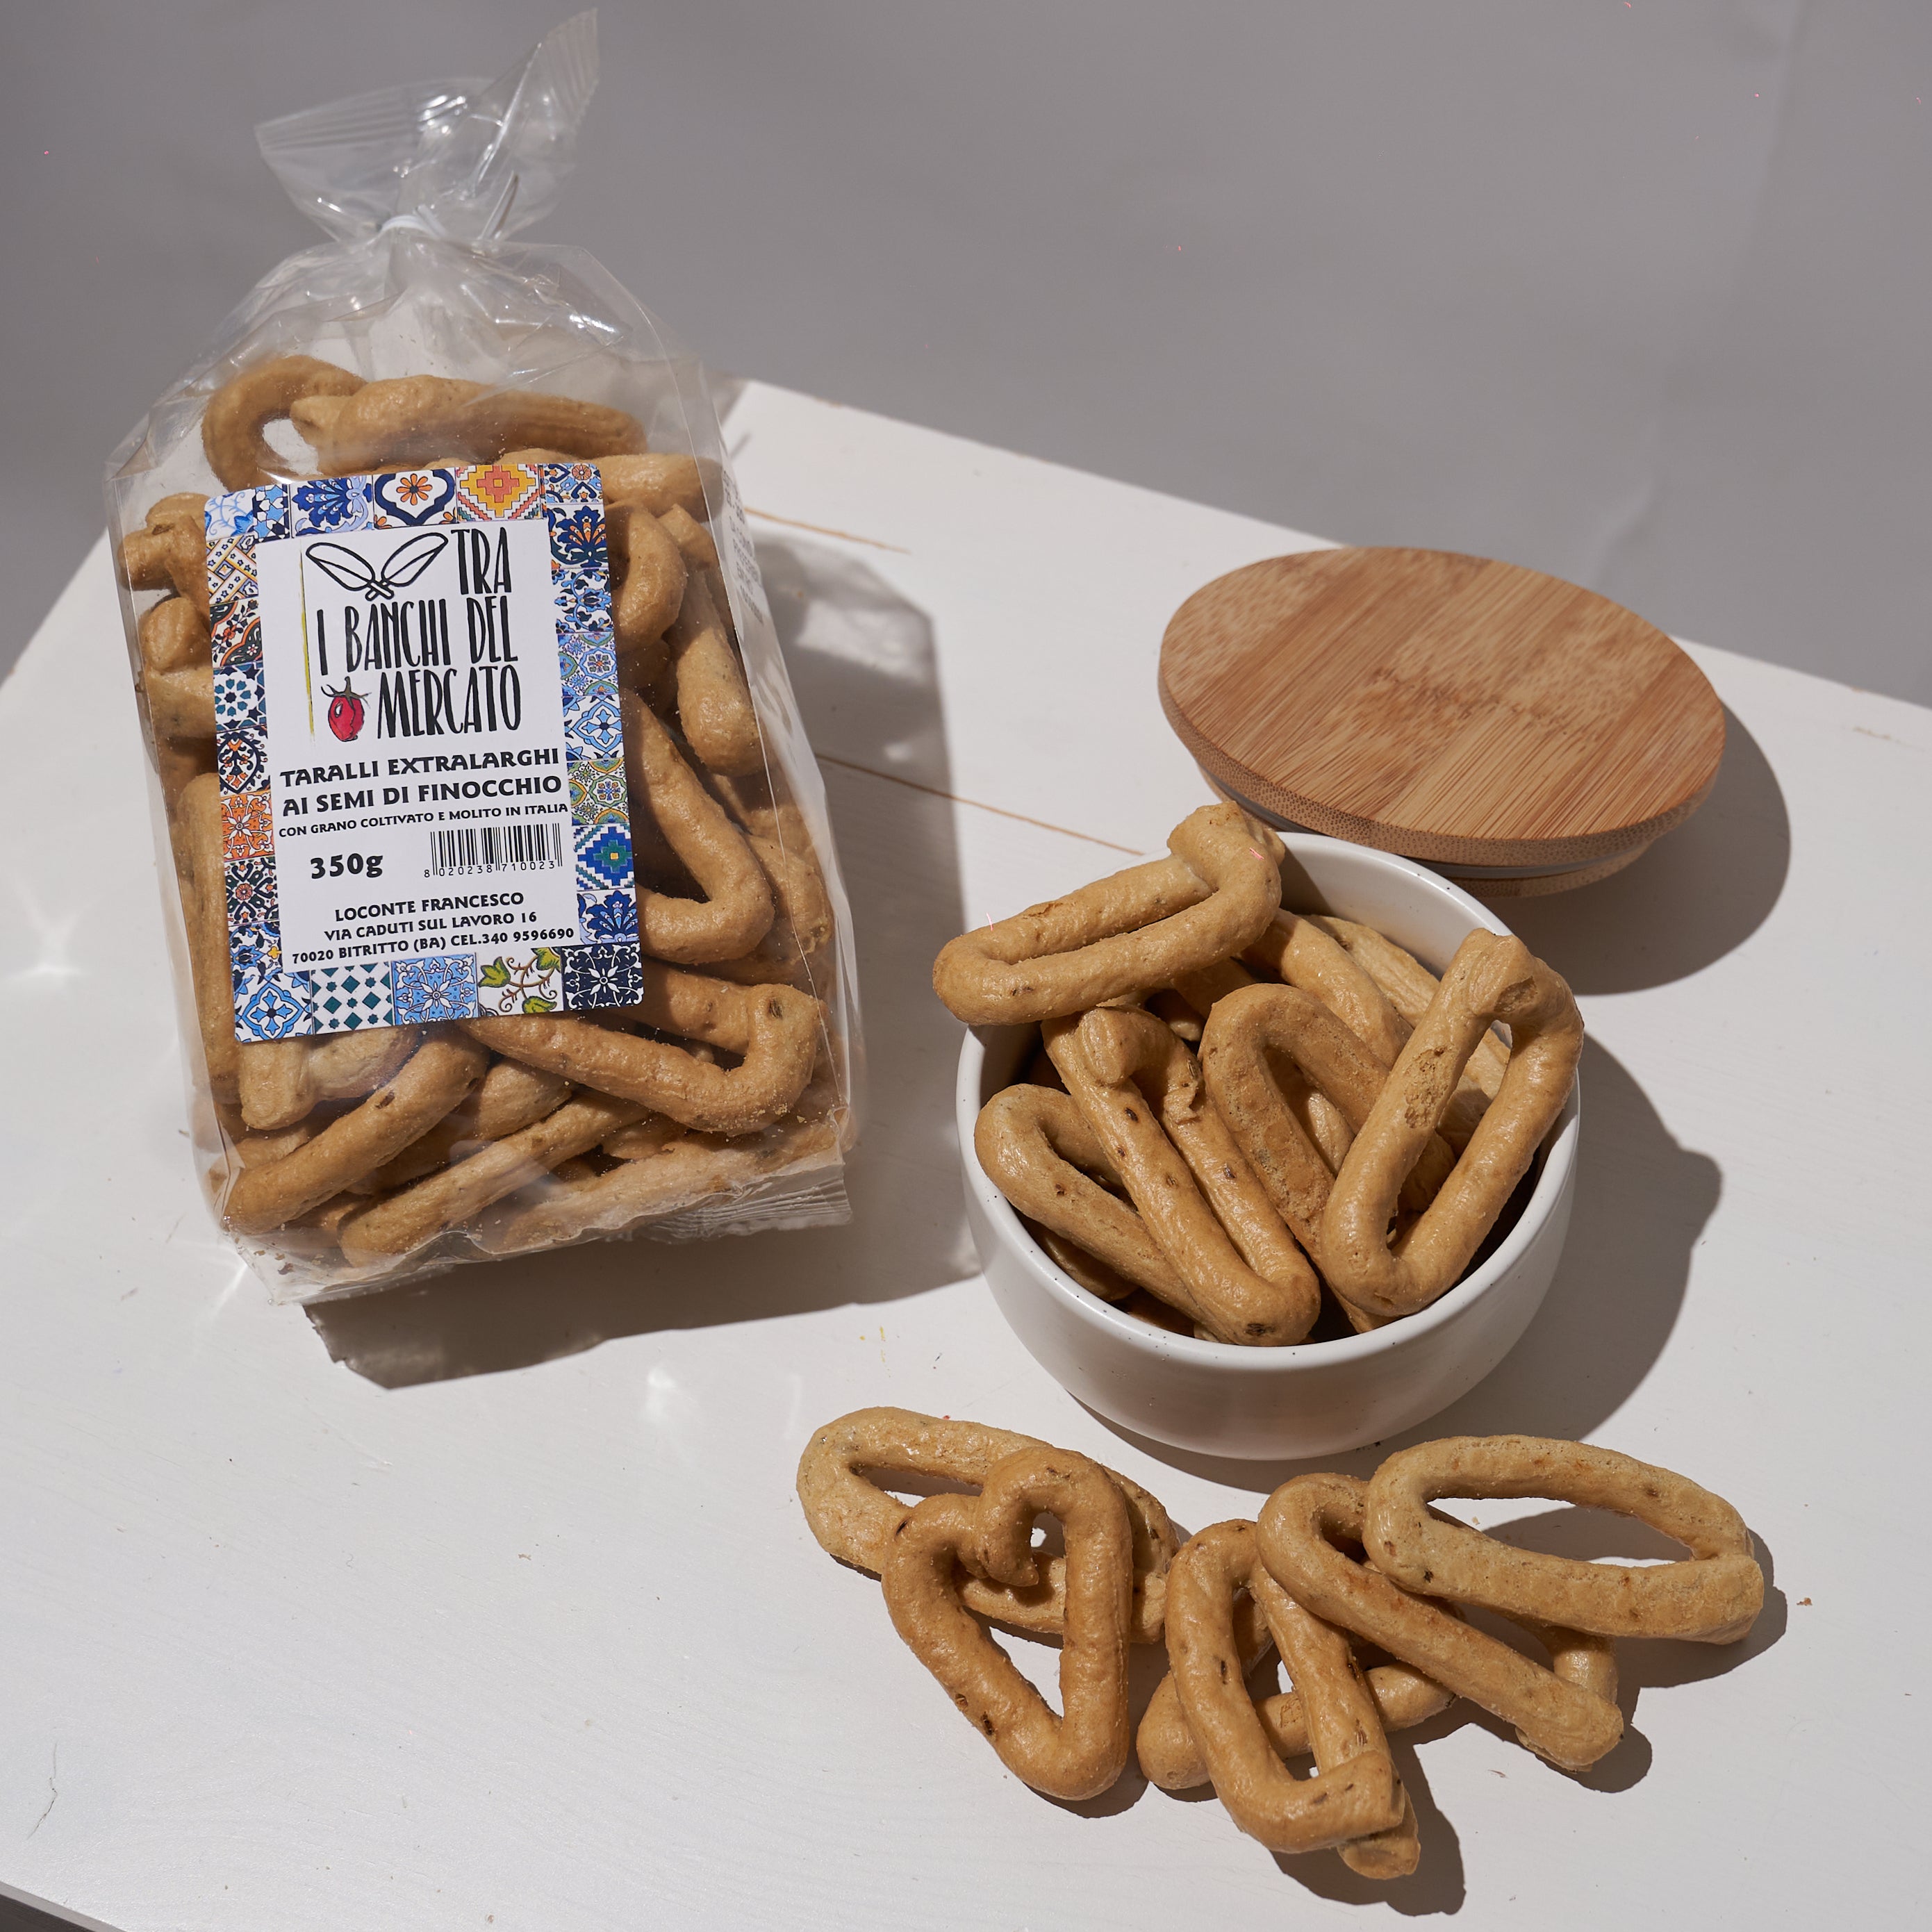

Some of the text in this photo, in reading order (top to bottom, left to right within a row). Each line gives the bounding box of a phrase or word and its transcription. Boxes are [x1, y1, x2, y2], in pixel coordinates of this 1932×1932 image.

[450, 527, 512, 595] TRA
[316, 595, 518, 676] I BANCHI DEL
[377, 664, 521, 739] MERCATO
[279, 748, 559, 788] TARALLI EXTRALARGHI
[283, 775, 562, 817] AI SEMI DI FINOCCHIO
[279, 803, 568, 838] CON GRANO COLTIVATO E MOLITO IN ITALIA
[310, 852, 383, 880] 350g
[324, 911, 537, 941] VIA CADUTI SUL LAVORO 16
[335, 892, 524, 922] LOCONTE FRANCESCO
[292, 927, 575, 964] 70020 BITRITTO (BA) CEL.340 9596690
